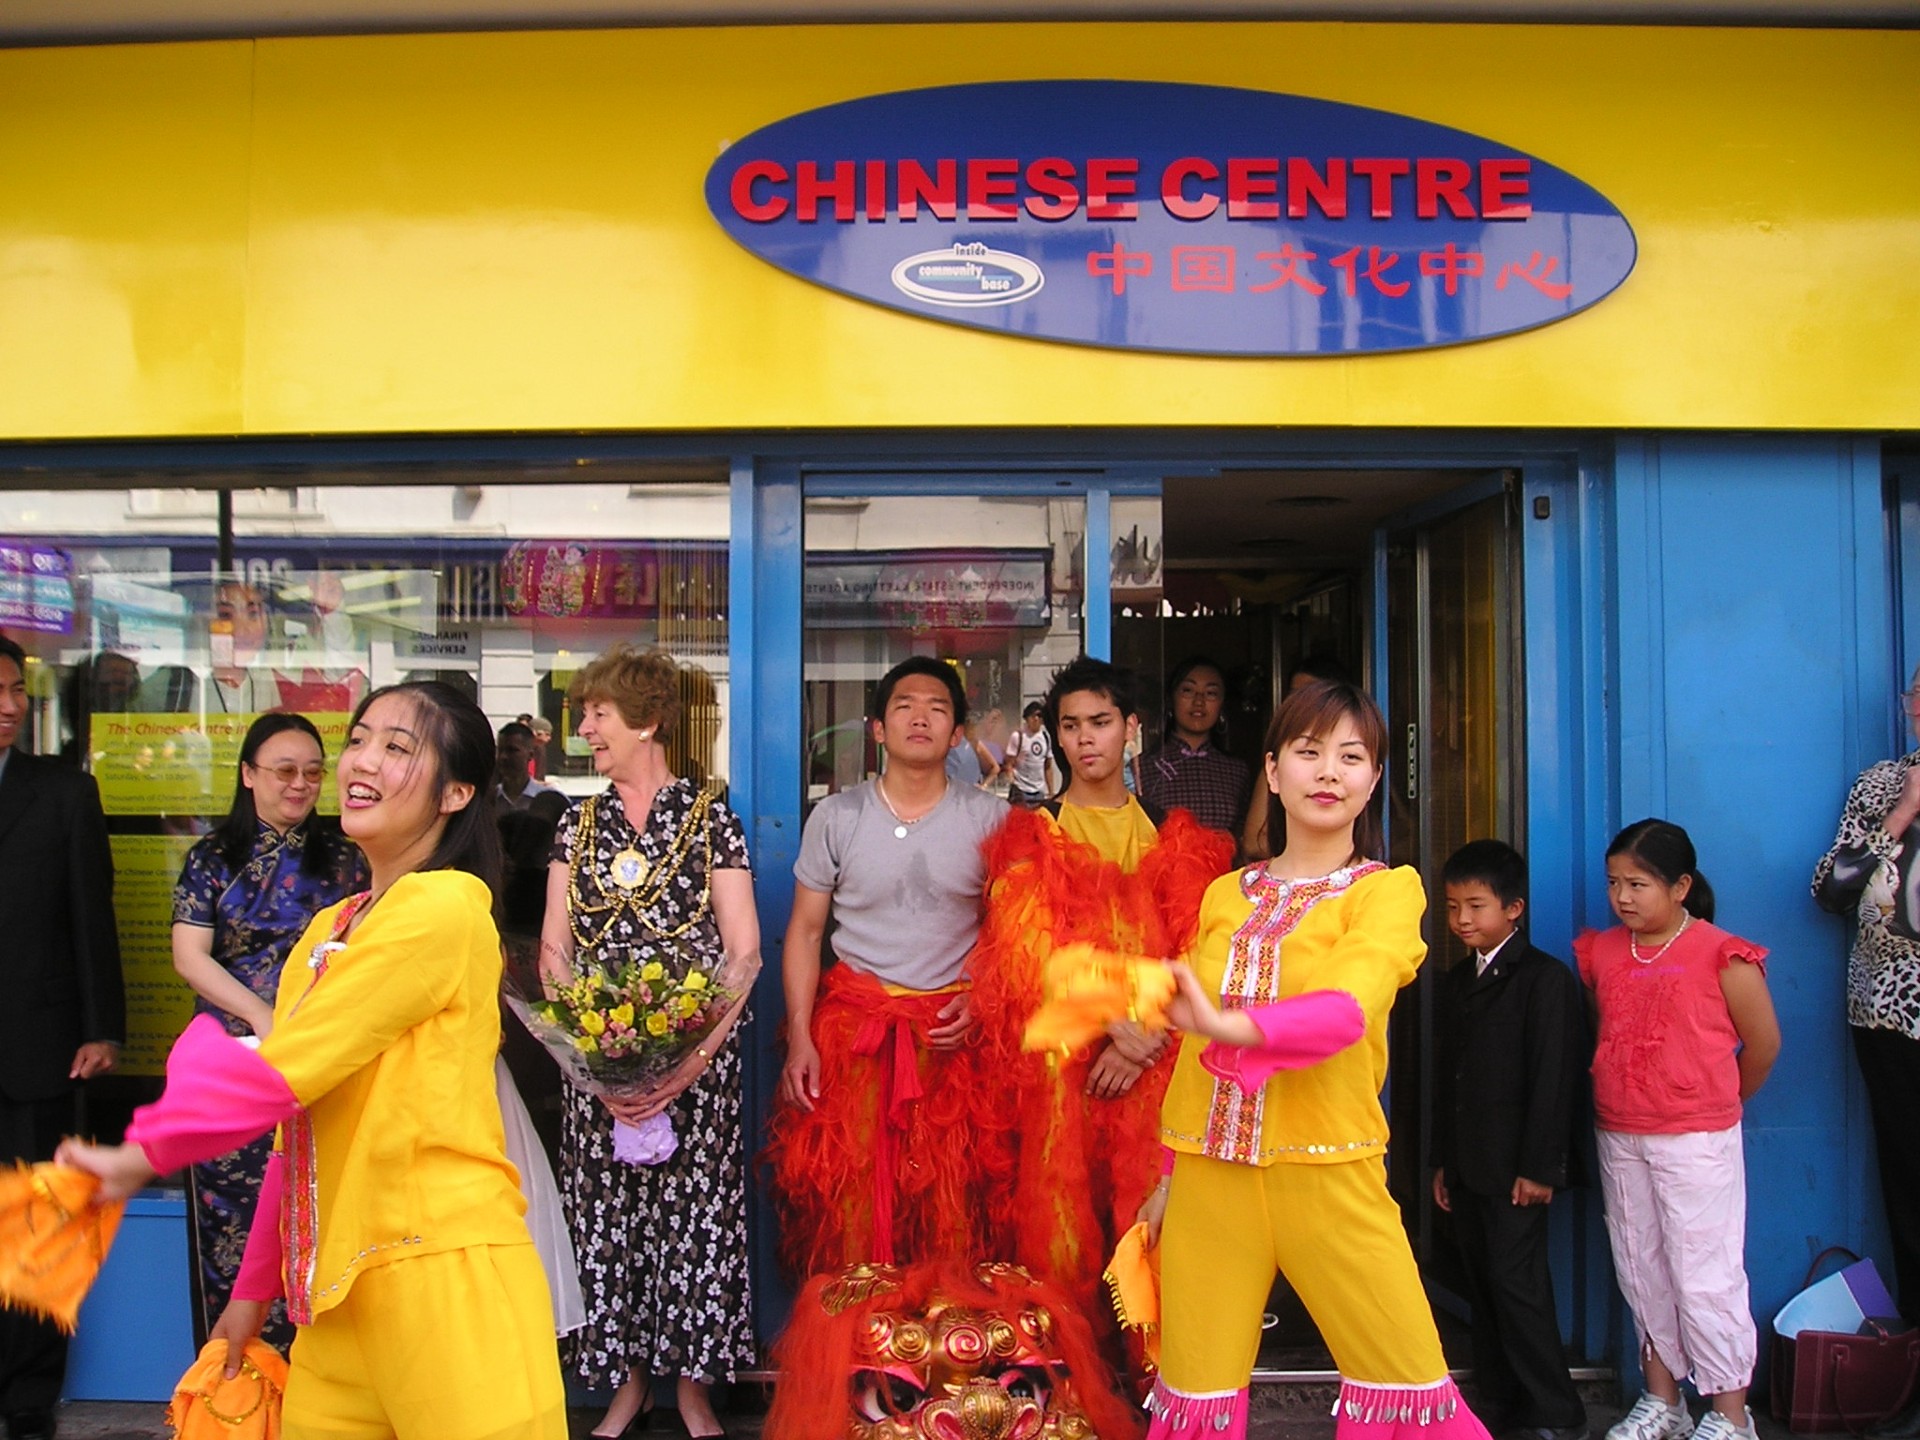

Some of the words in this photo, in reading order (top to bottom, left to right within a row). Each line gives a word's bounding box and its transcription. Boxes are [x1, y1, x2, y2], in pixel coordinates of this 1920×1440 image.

[730, 158, 1139, 221] CHINESE
[1161, 157, 1532, 220] CENTRE
[955, 245, 986, 256] inside
[918, 262, 984, 279] community
[1086, 243, 1573, 300] 中国文化中心
[981, 276, 1010, 290] base
[107, 722, 131, 735] The
[135, 722, 186, 736] Chinese
